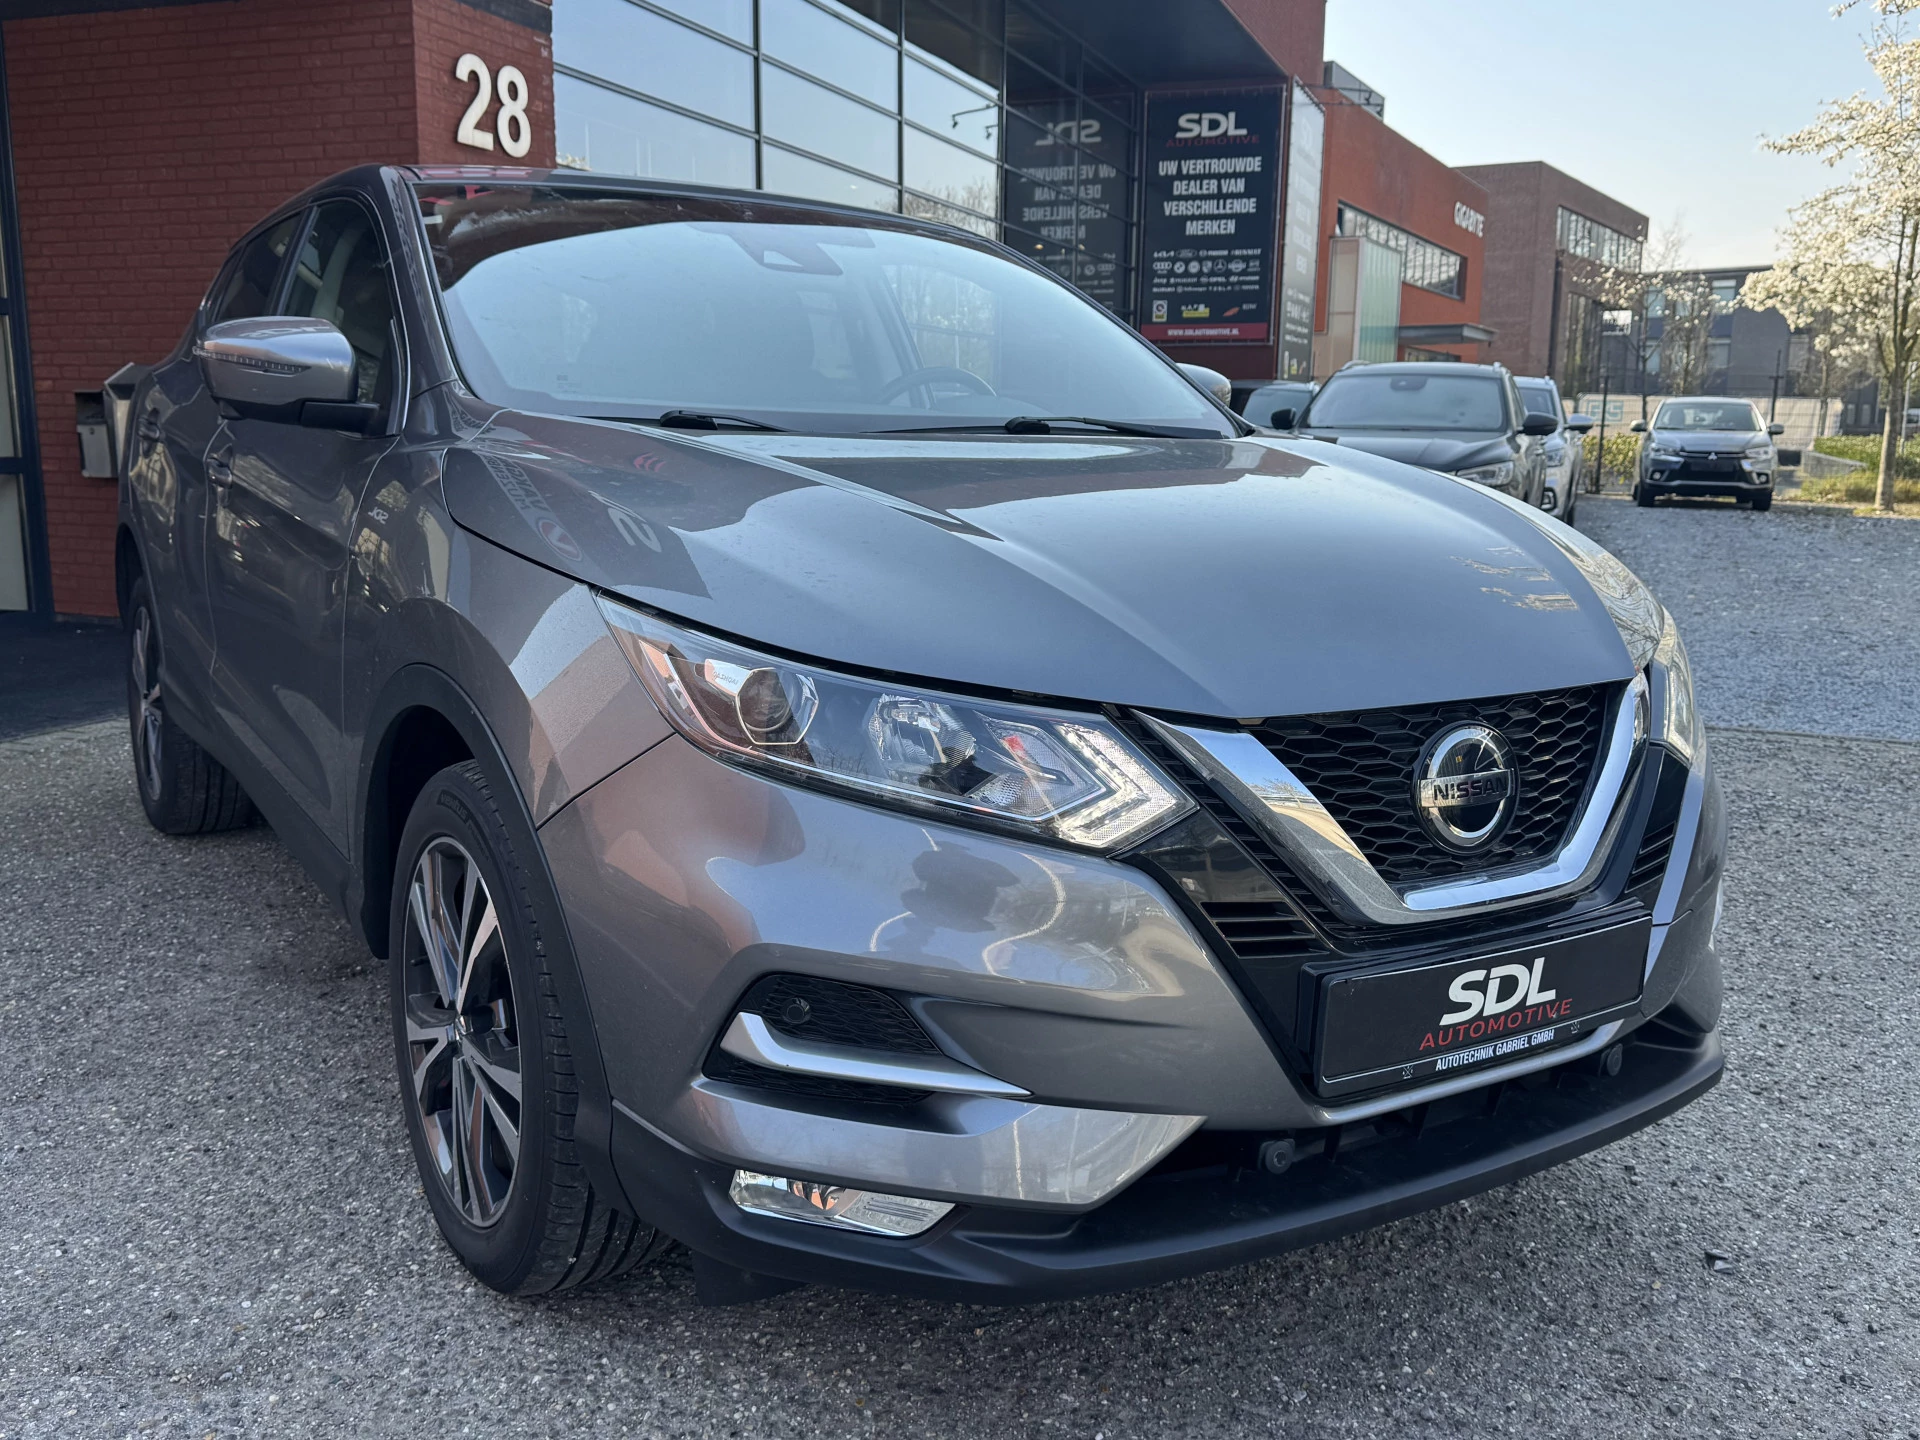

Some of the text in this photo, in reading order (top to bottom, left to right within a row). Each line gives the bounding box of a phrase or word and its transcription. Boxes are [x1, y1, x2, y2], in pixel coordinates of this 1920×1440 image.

[455, 53, 532, 158] 28
[1175, 111, 1248, 138] SDL
[1166, 135, 1260, 148] AUTOMOTIVE
[1159, 156, 1262, 176] UW VERTROUWDE
[1173, 178, 1245, 195] DEALER VAN
[1164, 198, 1257, 216] VERSCHILLENDE
[1186, 219, 1236, 236] MERKEN
[1433, 778, 1508, 801] NISSAN
[1439, 957, 1556, 1026] SDL
[1419, 998, 1573, 1050] AUTOMOTIVE
[1435, 1028, 1555, 1072] AUTOTECHNIK GABRIEL GMBH
